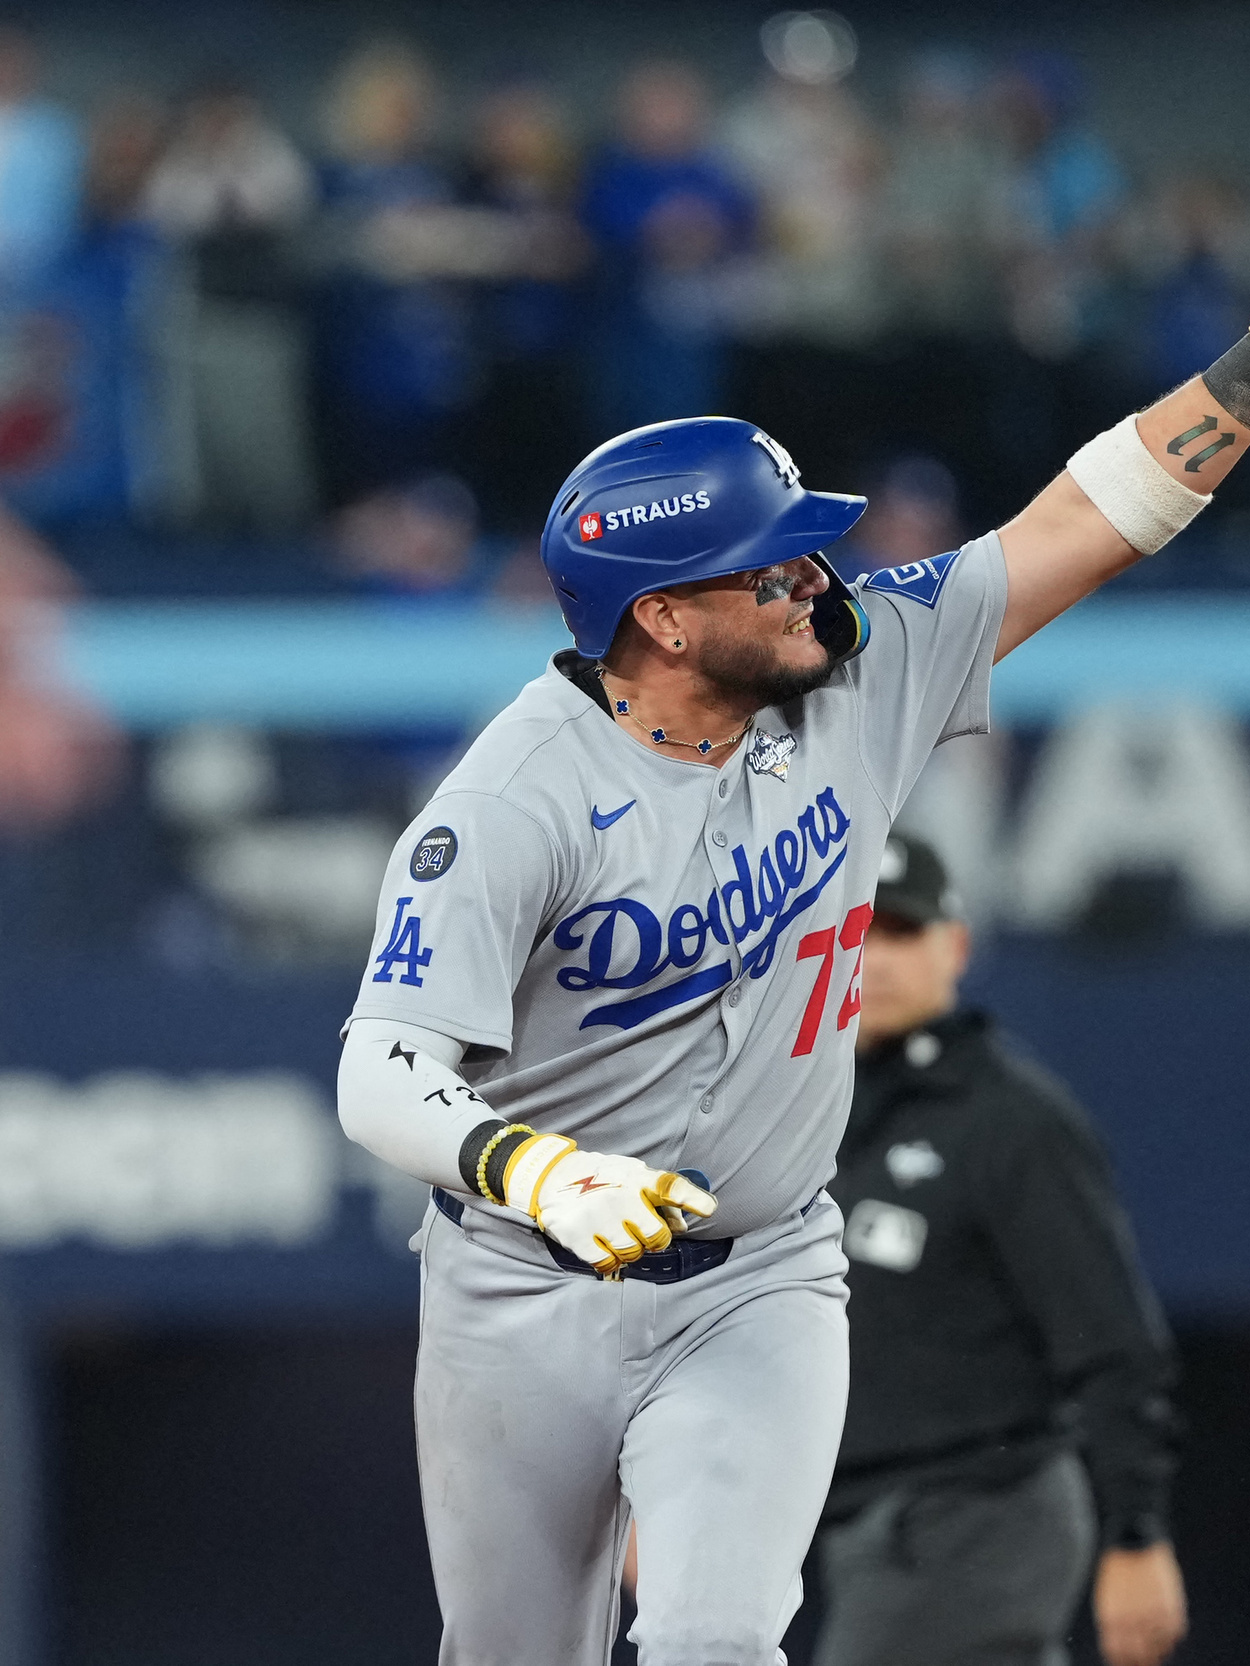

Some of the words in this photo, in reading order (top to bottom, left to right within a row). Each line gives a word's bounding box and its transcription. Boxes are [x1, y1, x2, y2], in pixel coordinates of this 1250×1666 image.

[606, 491, 711, 531] STRAUSS
[749, 748, 776, 771] World
[416, 846, 446, 871] 34
[553, 786, 851, 991] Dodgers
[372, 897, 433, 988] LA
